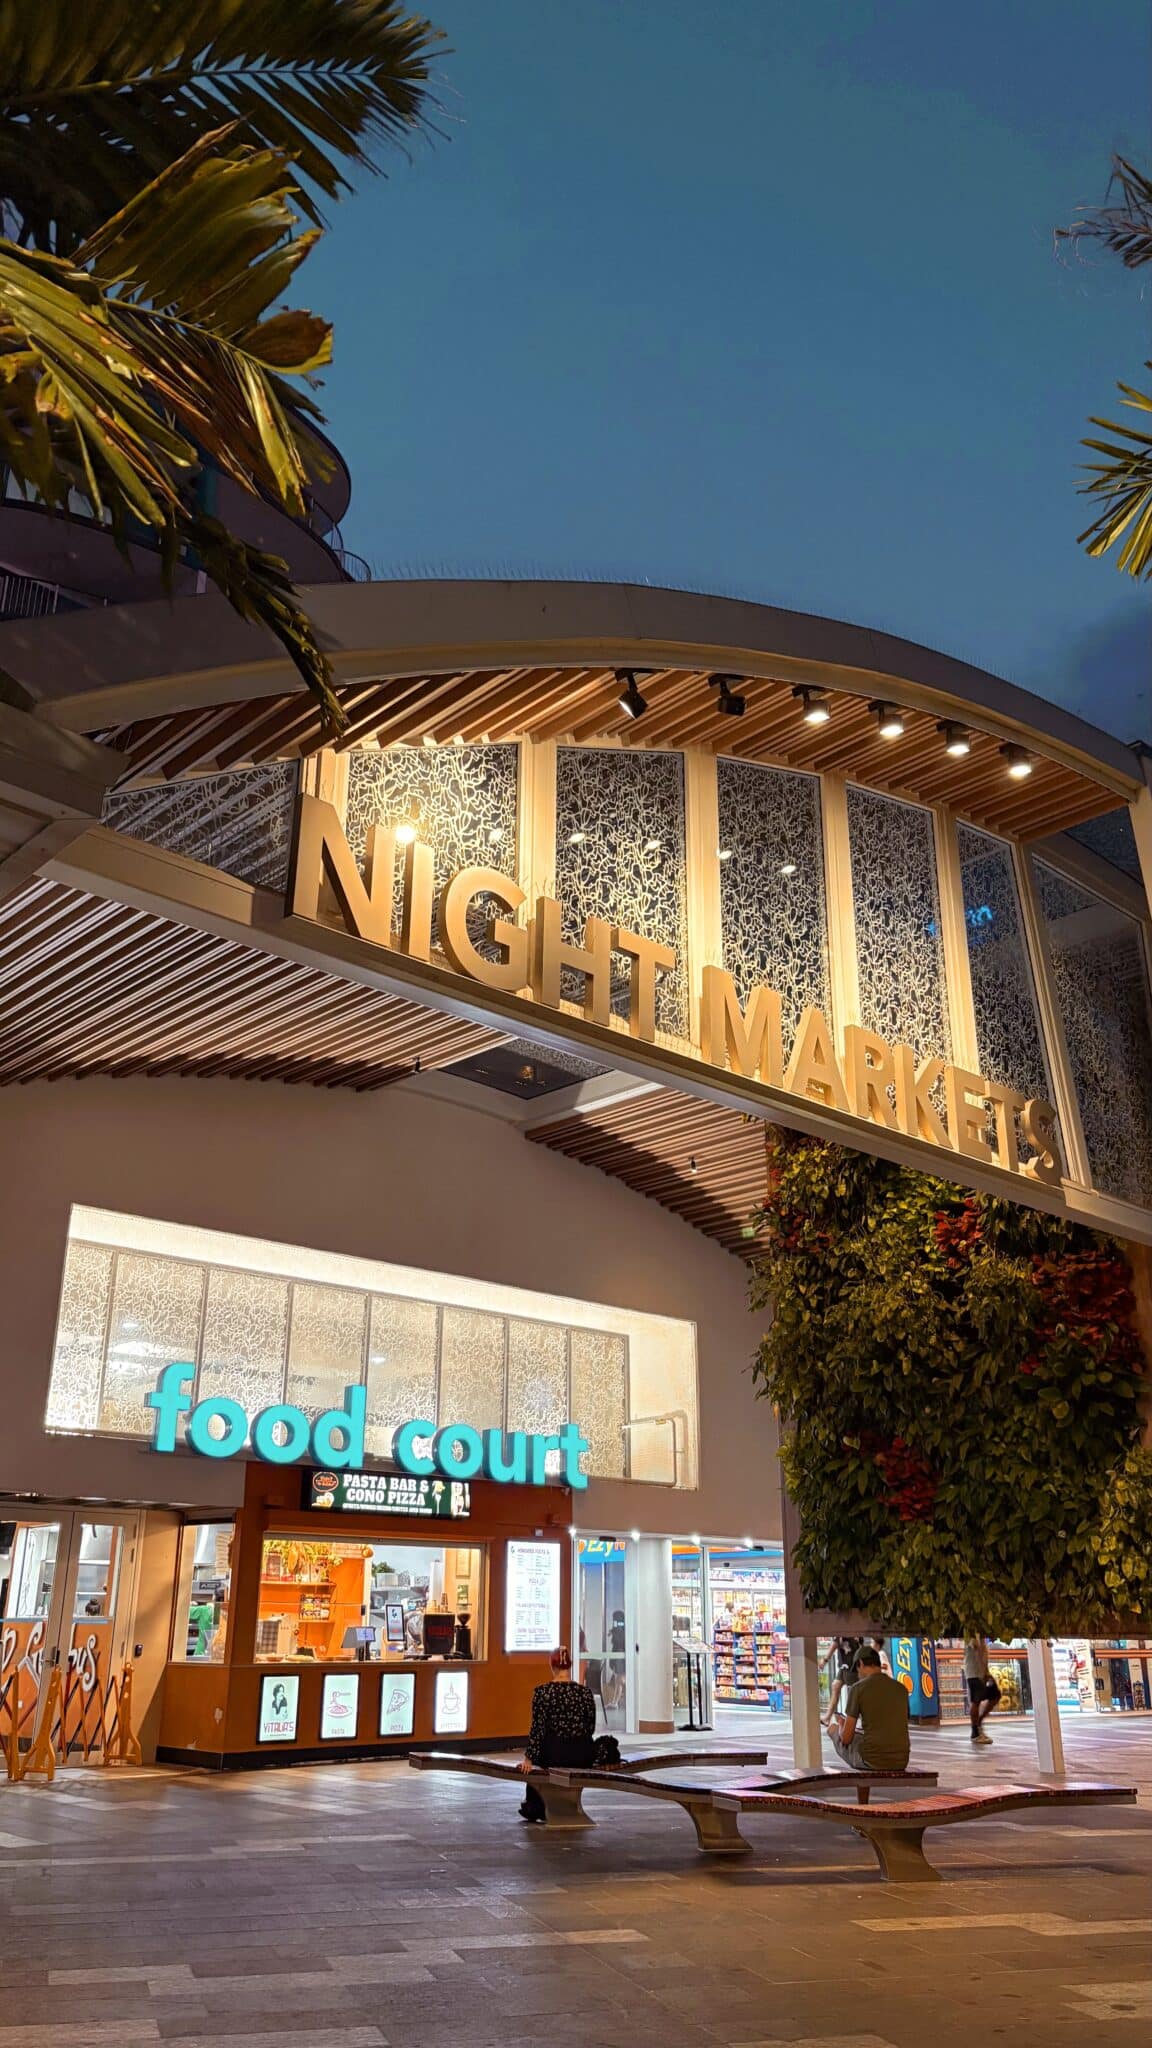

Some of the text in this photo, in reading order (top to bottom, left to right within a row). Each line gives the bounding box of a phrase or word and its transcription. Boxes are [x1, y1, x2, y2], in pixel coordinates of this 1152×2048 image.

[285, 794, 1062, 1186] NIGHT MARKETS
[144, 1361, 589, 1489] food court
[343, 1473, 387, 1489] PASTA
[390, 1477, 417, 1492] BAR
[419, 1479, 429, 1493] &
[346, 1488, 426, 1506] CONO PIZZA
